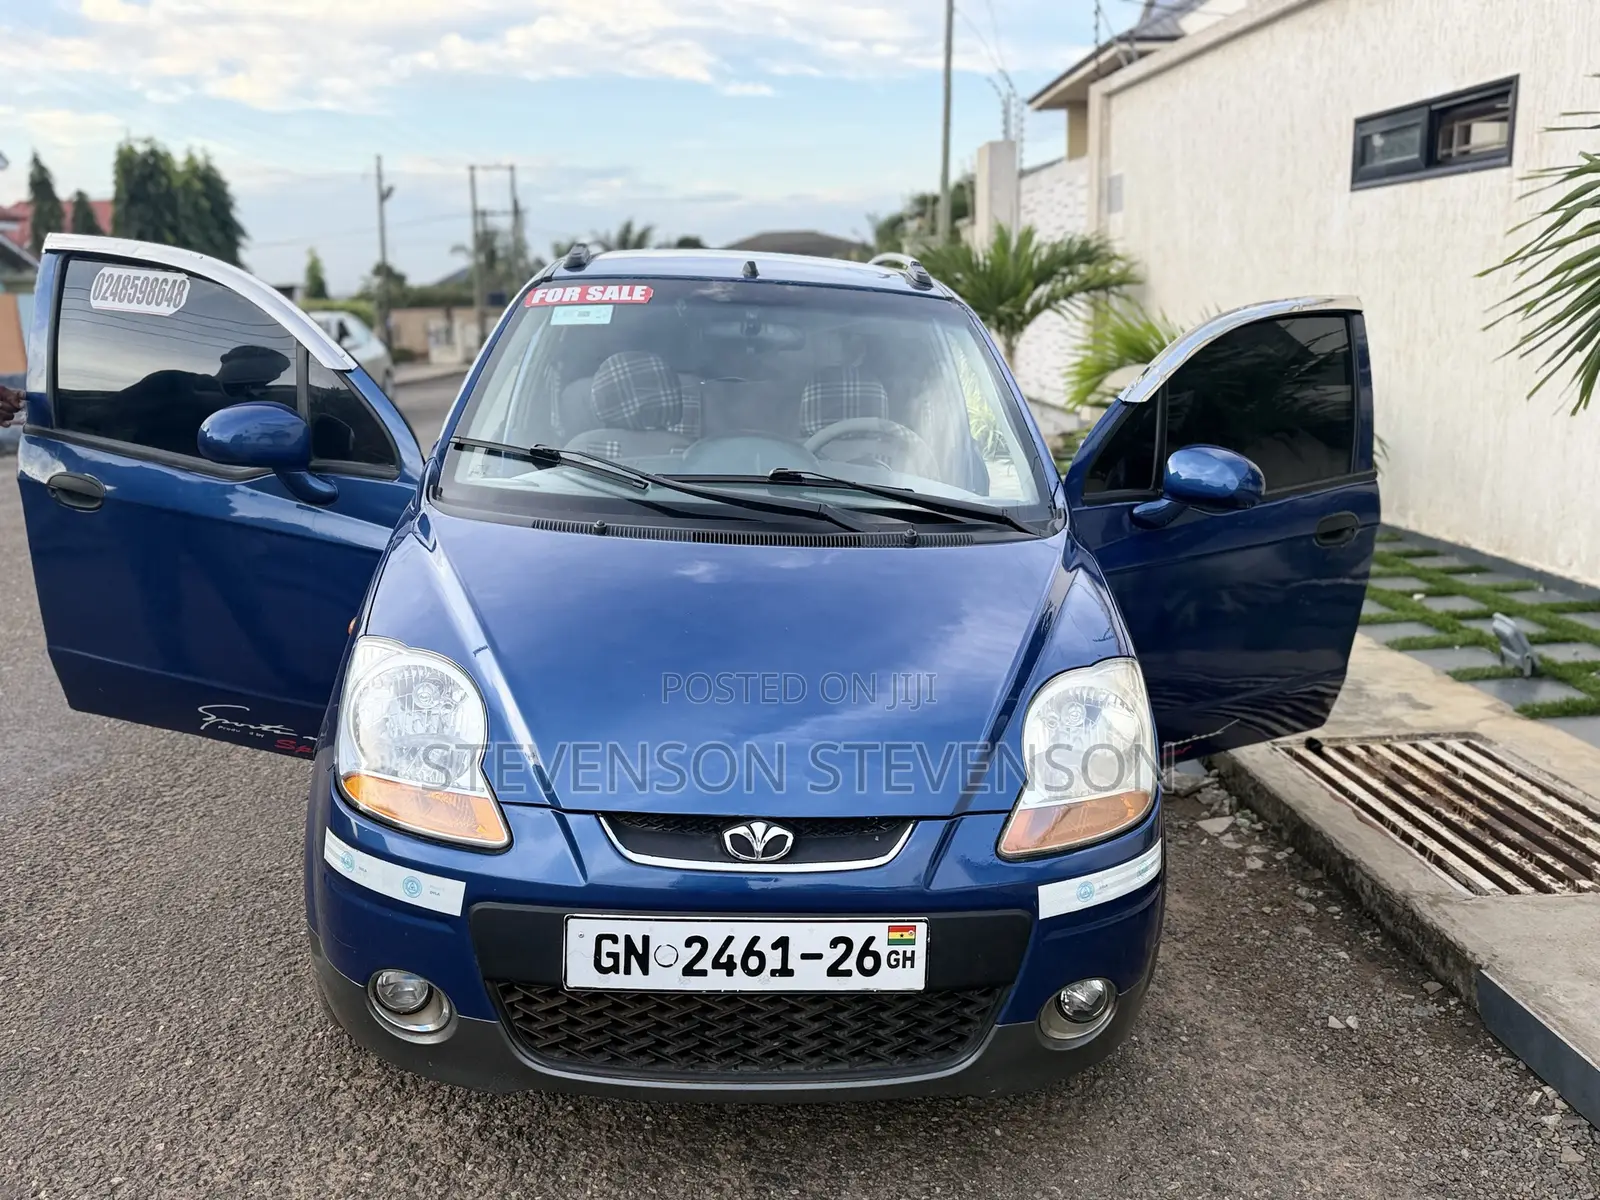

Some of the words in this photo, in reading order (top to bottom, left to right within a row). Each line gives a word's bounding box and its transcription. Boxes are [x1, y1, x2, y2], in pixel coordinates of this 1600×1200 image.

[92, 272, 187, 309] 0248598648
[531, 287, 581, 304] FOR
[586, 285, 648, 301] SALE
[593, 933, 650, 976] GN
[681, 935, 882, 978] 2461-26
[886, 950, 916, 970] GH
